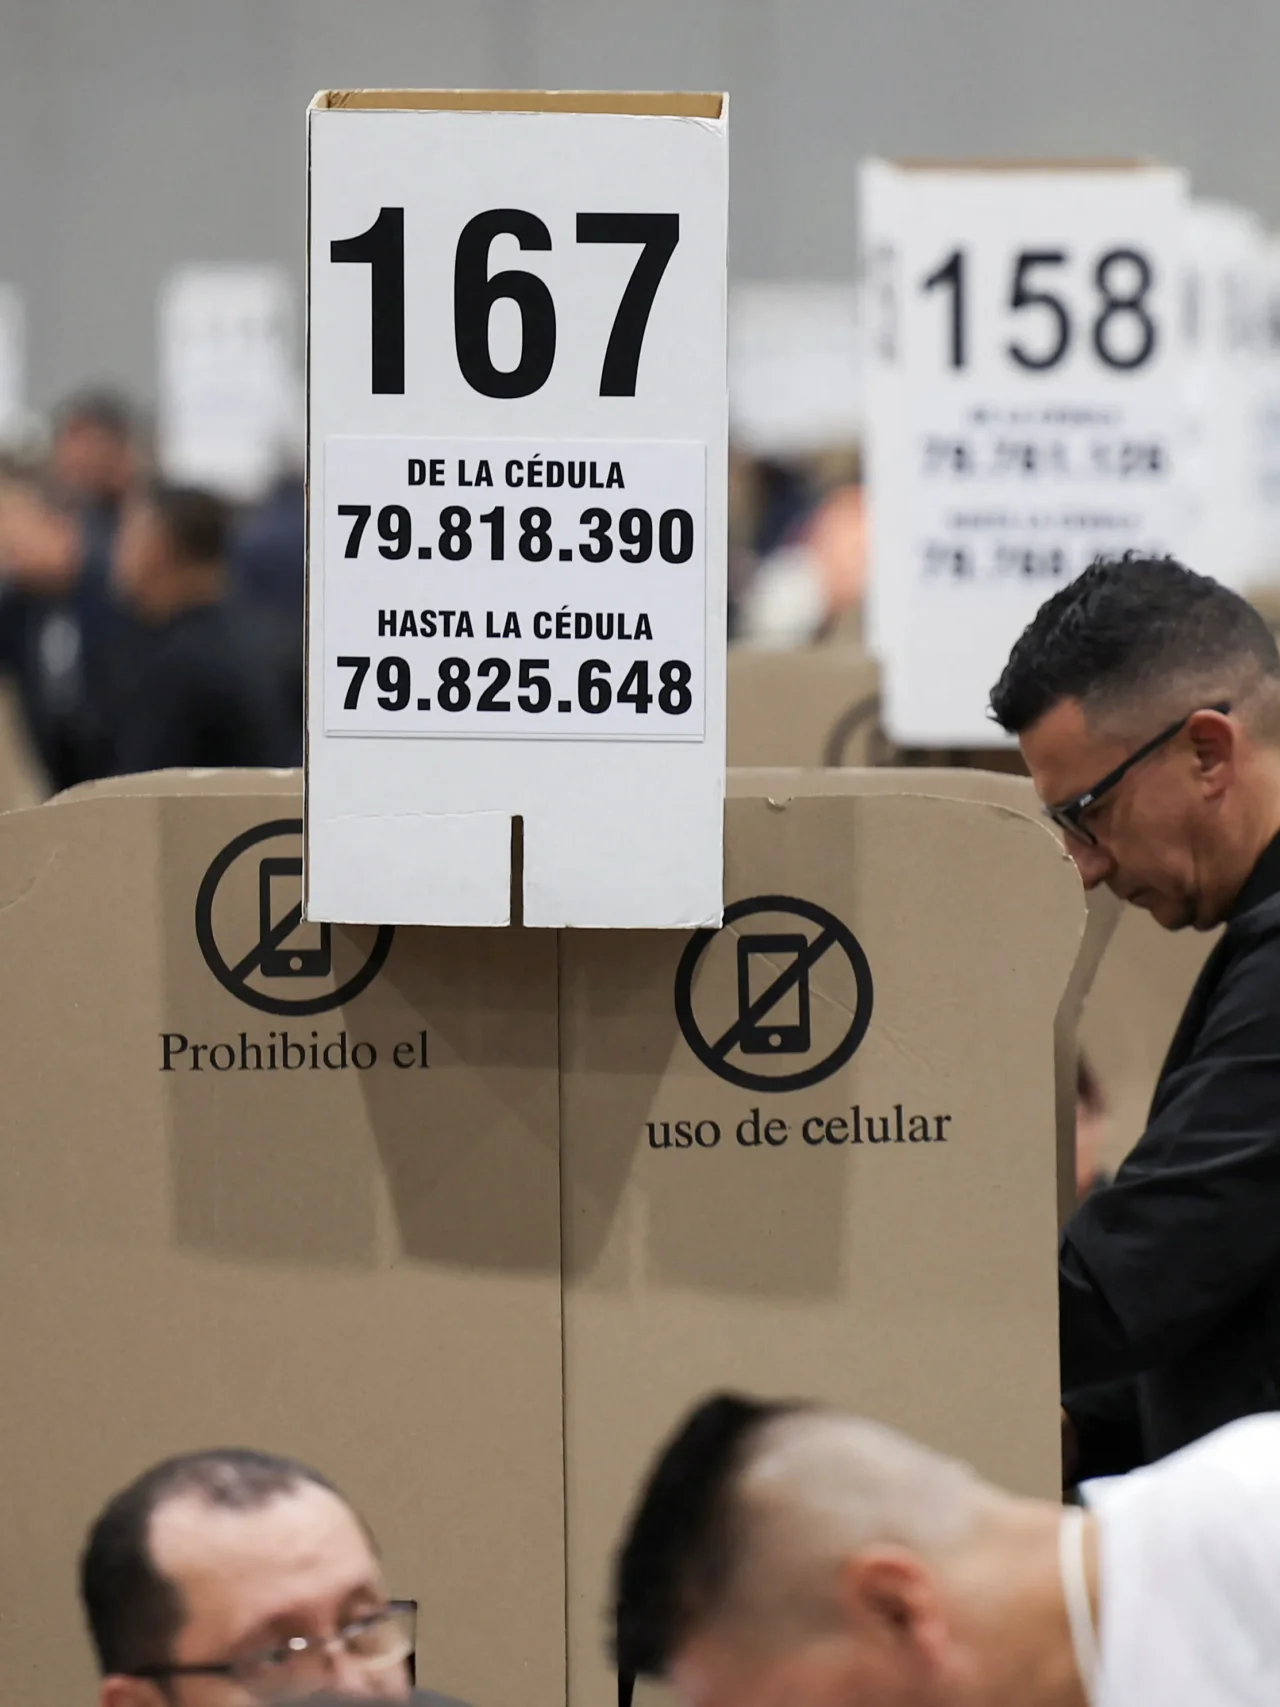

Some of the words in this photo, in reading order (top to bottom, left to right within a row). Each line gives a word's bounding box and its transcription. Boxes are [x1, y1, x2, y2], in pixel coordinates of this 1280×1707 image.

[329, 206, 680, 400] 167
[921, 246, 1158, 373] 158
[408, 458, 446, 487] DE
[457, 459, 494, 488] LA
[504, 453, 625, 489] CÉDULA
[337, 504, 694, 565] 79.818.390
[378, 609, 475, 639] HASTA
[486, 611, 522, 639] LA
[533, 605, 654, 641] CÉDULA
[336, 655, 693, 716] 79.825.648
[159, 1031, 378, 1072] Prohibido
[391, 1030, 430, 1070] el
[645, 1120, 722, 1150] uso
[735, 1107, 790, 1148] de
[801, 1104, 953, 1147] celular
